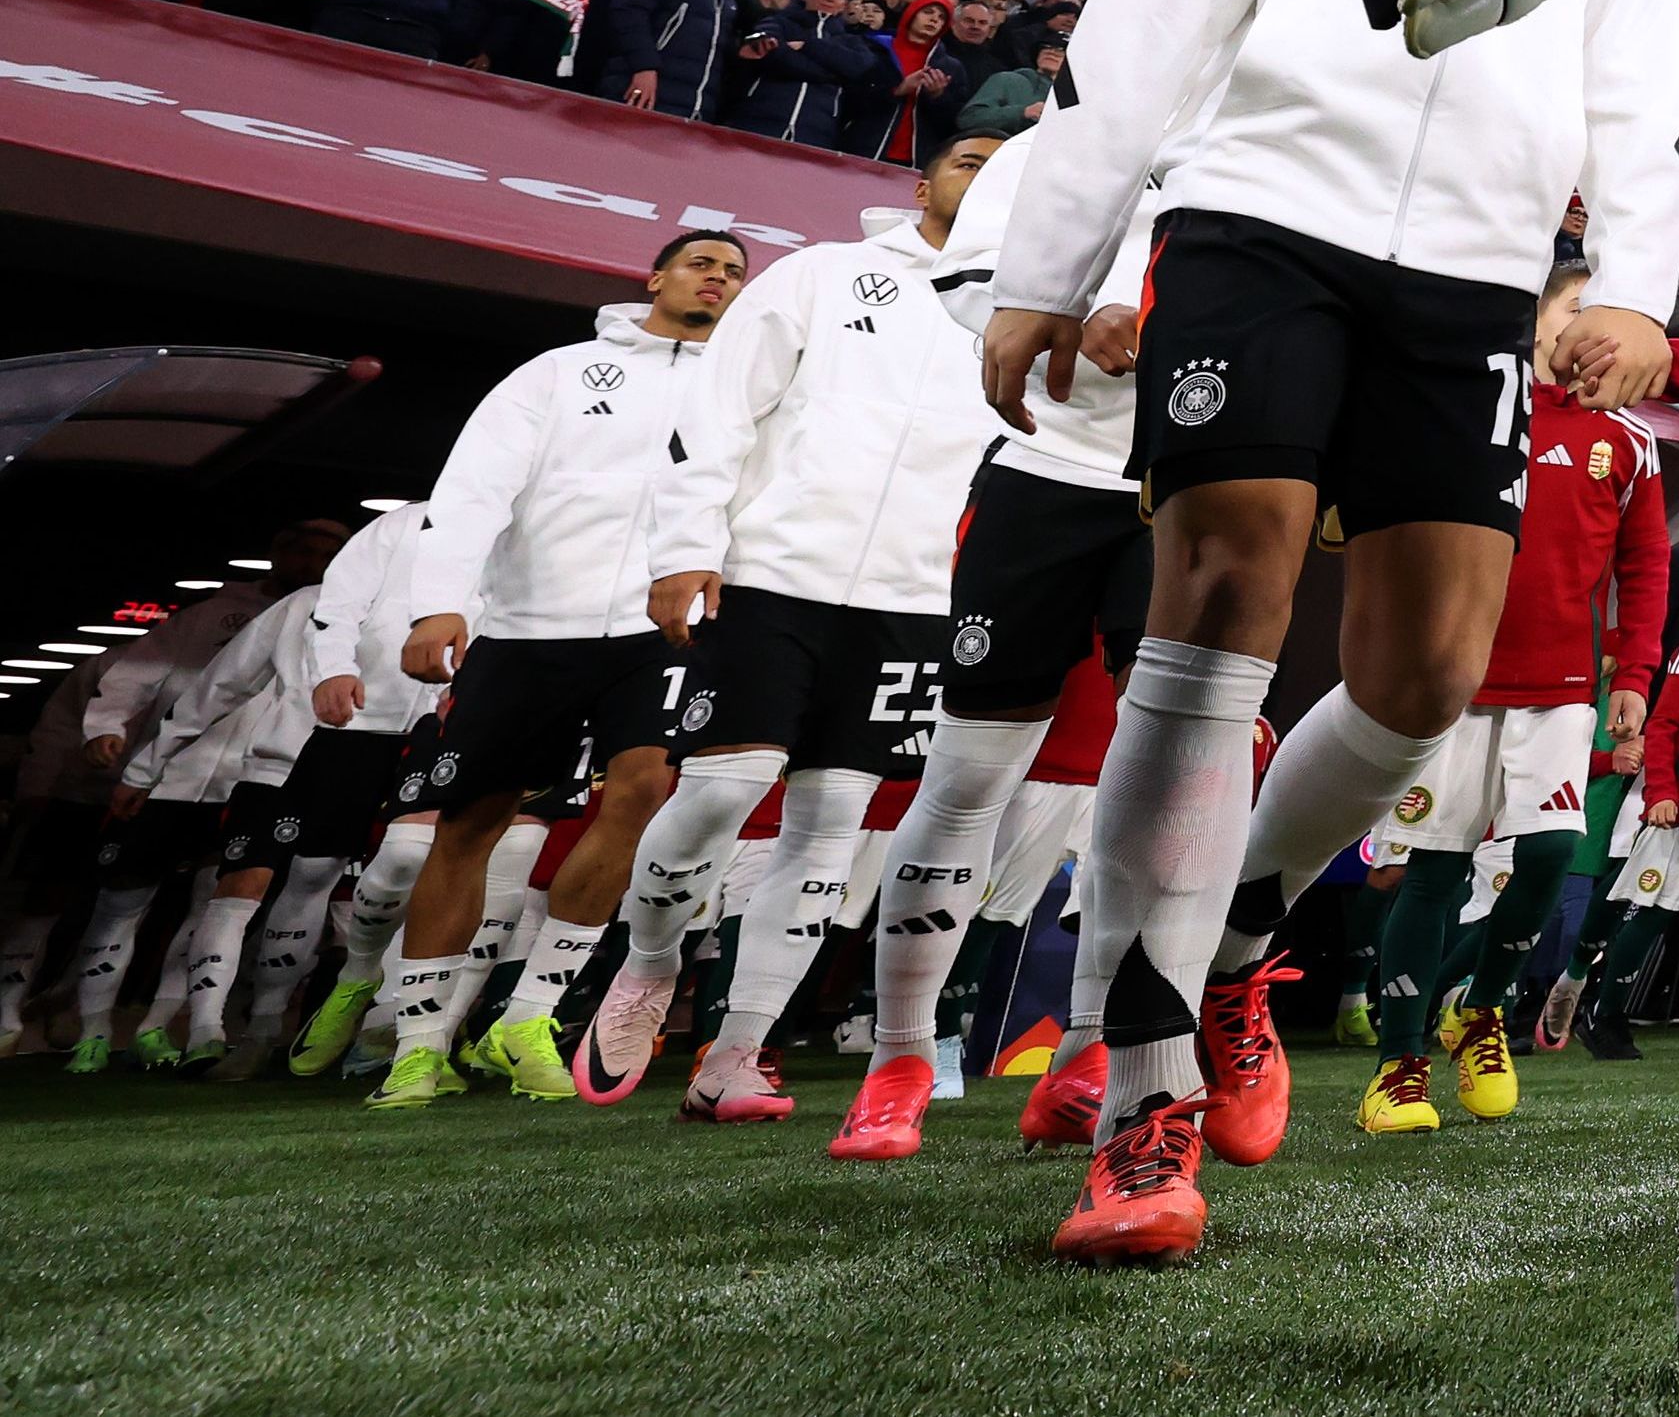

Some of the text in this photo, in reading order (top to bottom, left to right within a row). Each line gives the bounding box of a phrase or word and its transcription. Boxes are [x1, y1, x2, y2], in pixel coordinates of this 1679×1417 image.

[648, 860, 713, 881] DFB
[896, 863, 973, 885] DFB
[483, 918, 516, 931] FB
[187, 954, 222, 974] DFB
[402, 970, 450, 987] DFB
